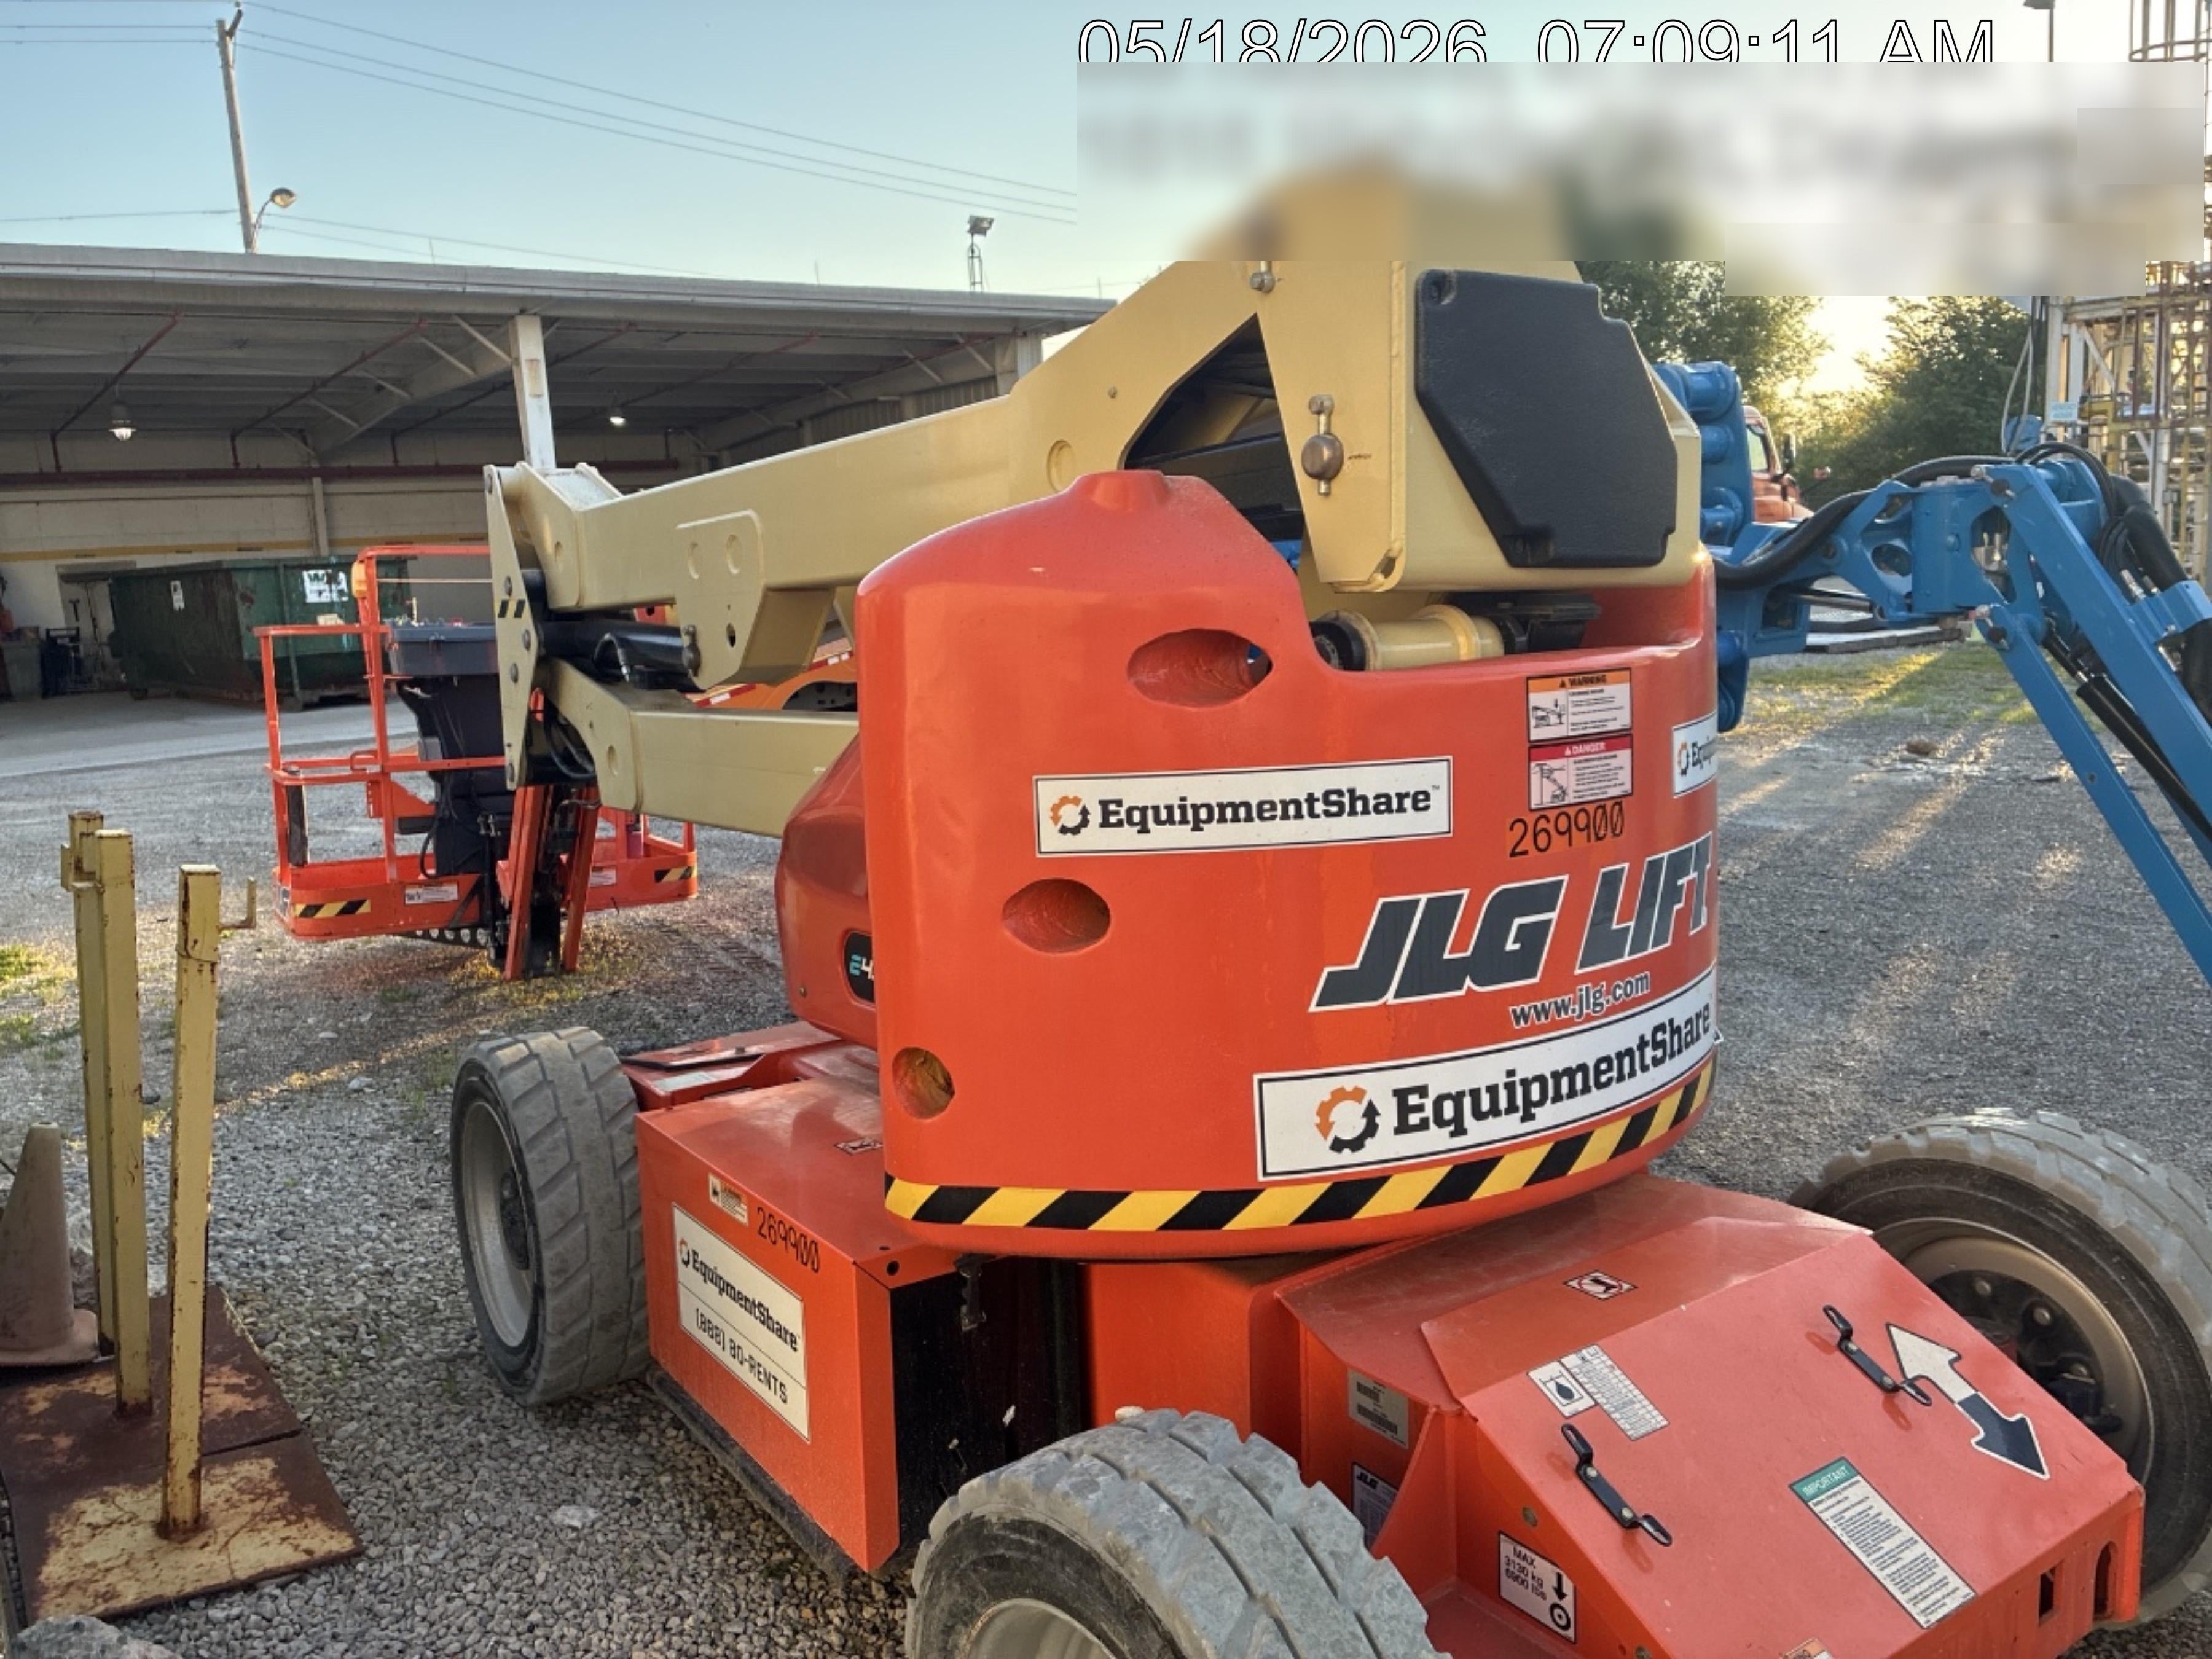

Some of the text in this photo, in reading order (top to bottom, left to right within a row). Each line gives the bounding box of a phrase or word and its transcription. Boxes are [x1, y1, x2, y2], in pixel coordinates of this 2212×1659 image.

[1508, 801, 1625, 858] 269900
[1309, 831, 1713, 1013] JLG LIFT
[1510, 972, 1650, 1029] www.jlg.com
[1392, 1002, 1709, 1137] EquipmentShare
[756, 1207, 821, 1273] 269900
[691, 1249, 798, 1352] EquipmentShare
[1803, 1465, 1849, 1495] IMPORTANT
